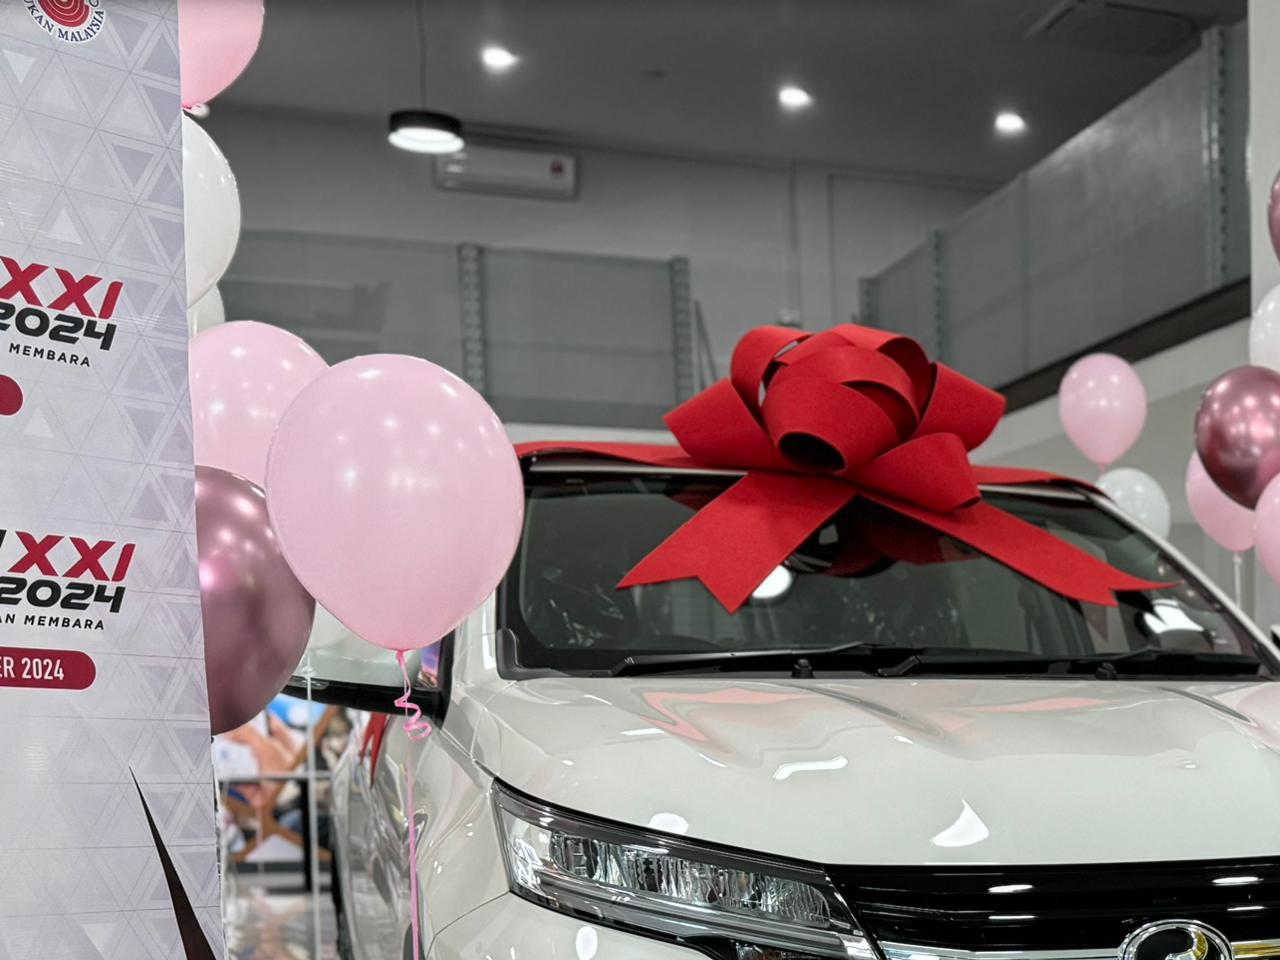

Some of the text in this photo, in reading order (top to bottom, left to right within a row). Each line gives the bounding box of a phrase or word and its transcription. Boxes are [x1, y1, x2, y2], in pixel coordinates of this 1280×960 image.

[57, 10, 104, 42] MALAYSIA
[9, 343, 90, 367] MEMBARA
[8, 531, 136, 582] XXI
[0, 576, 126, 613] 2024
[24, 615, 104, 630] MEMBARA
[21, 658, 64, 680] 2024
